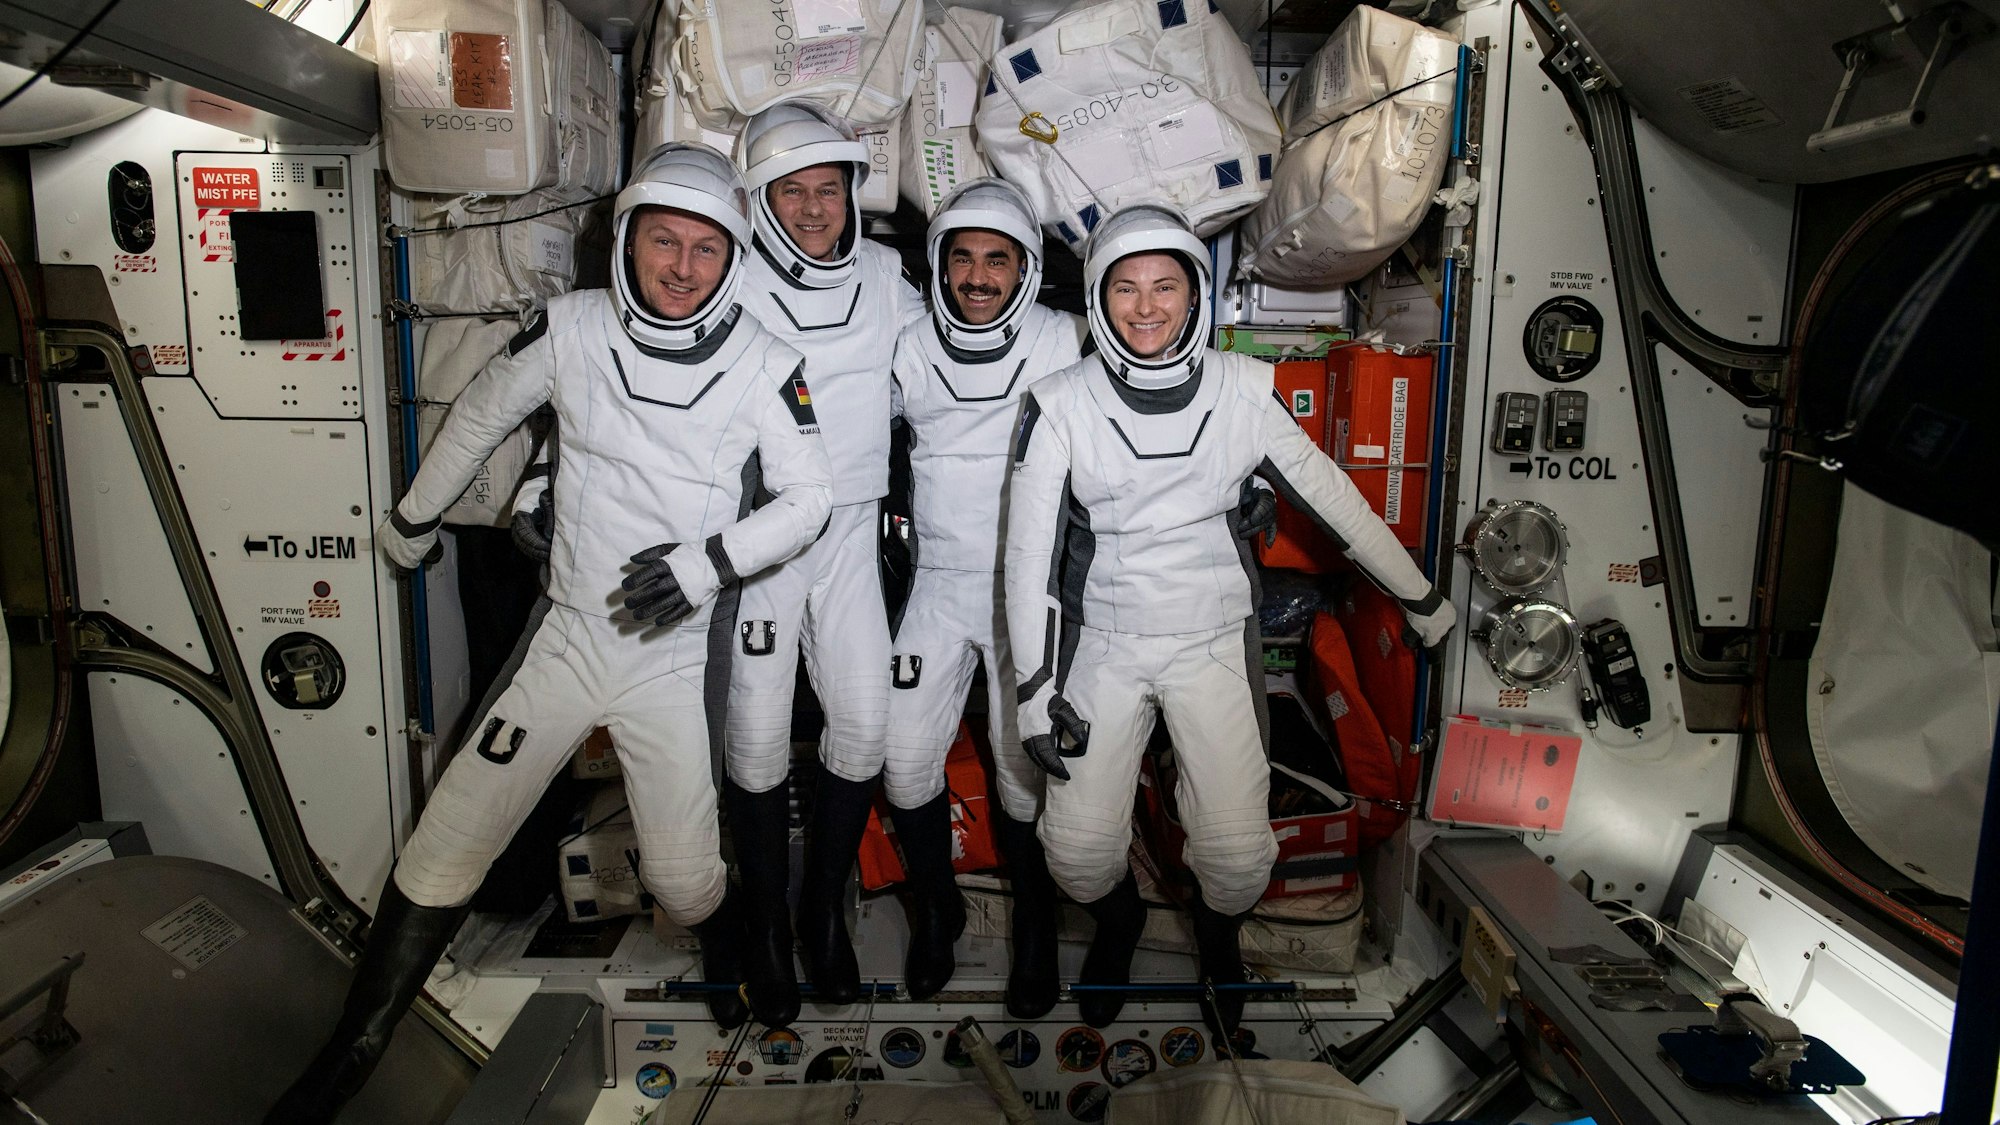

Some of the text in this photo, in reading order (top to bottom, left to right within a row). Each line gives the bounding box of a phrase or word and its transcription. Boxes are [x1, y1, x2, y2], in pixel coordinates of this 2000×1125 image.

[774, 0, 795, 86] 0.5-504
[456, 69, 468, 92] ISS
[470, 38, 484, 104] LEAK KIT
[487, 65, 496, 84] #2
[1058, 73, 1178, 132] 3.0-4085
[421, 114, 513, 132] 0.5-5054
[873, 136, 889, 175] 1.0-5
[1402, 105, 1445, 183] 1.0-1073
[202, 173, 251, 185] WATER
[197, 188, 257, 200] MIST PFE
[1387, 380, 1406, 522] AMMONIA CARTRIDGE BAG
[1535, 457, 1616, 480] To COL
[268, 536, 356, 559] To JEM
[588, 761, 617, 774] 0.5-
[1023, 1091, 1060, 1110] PLM
